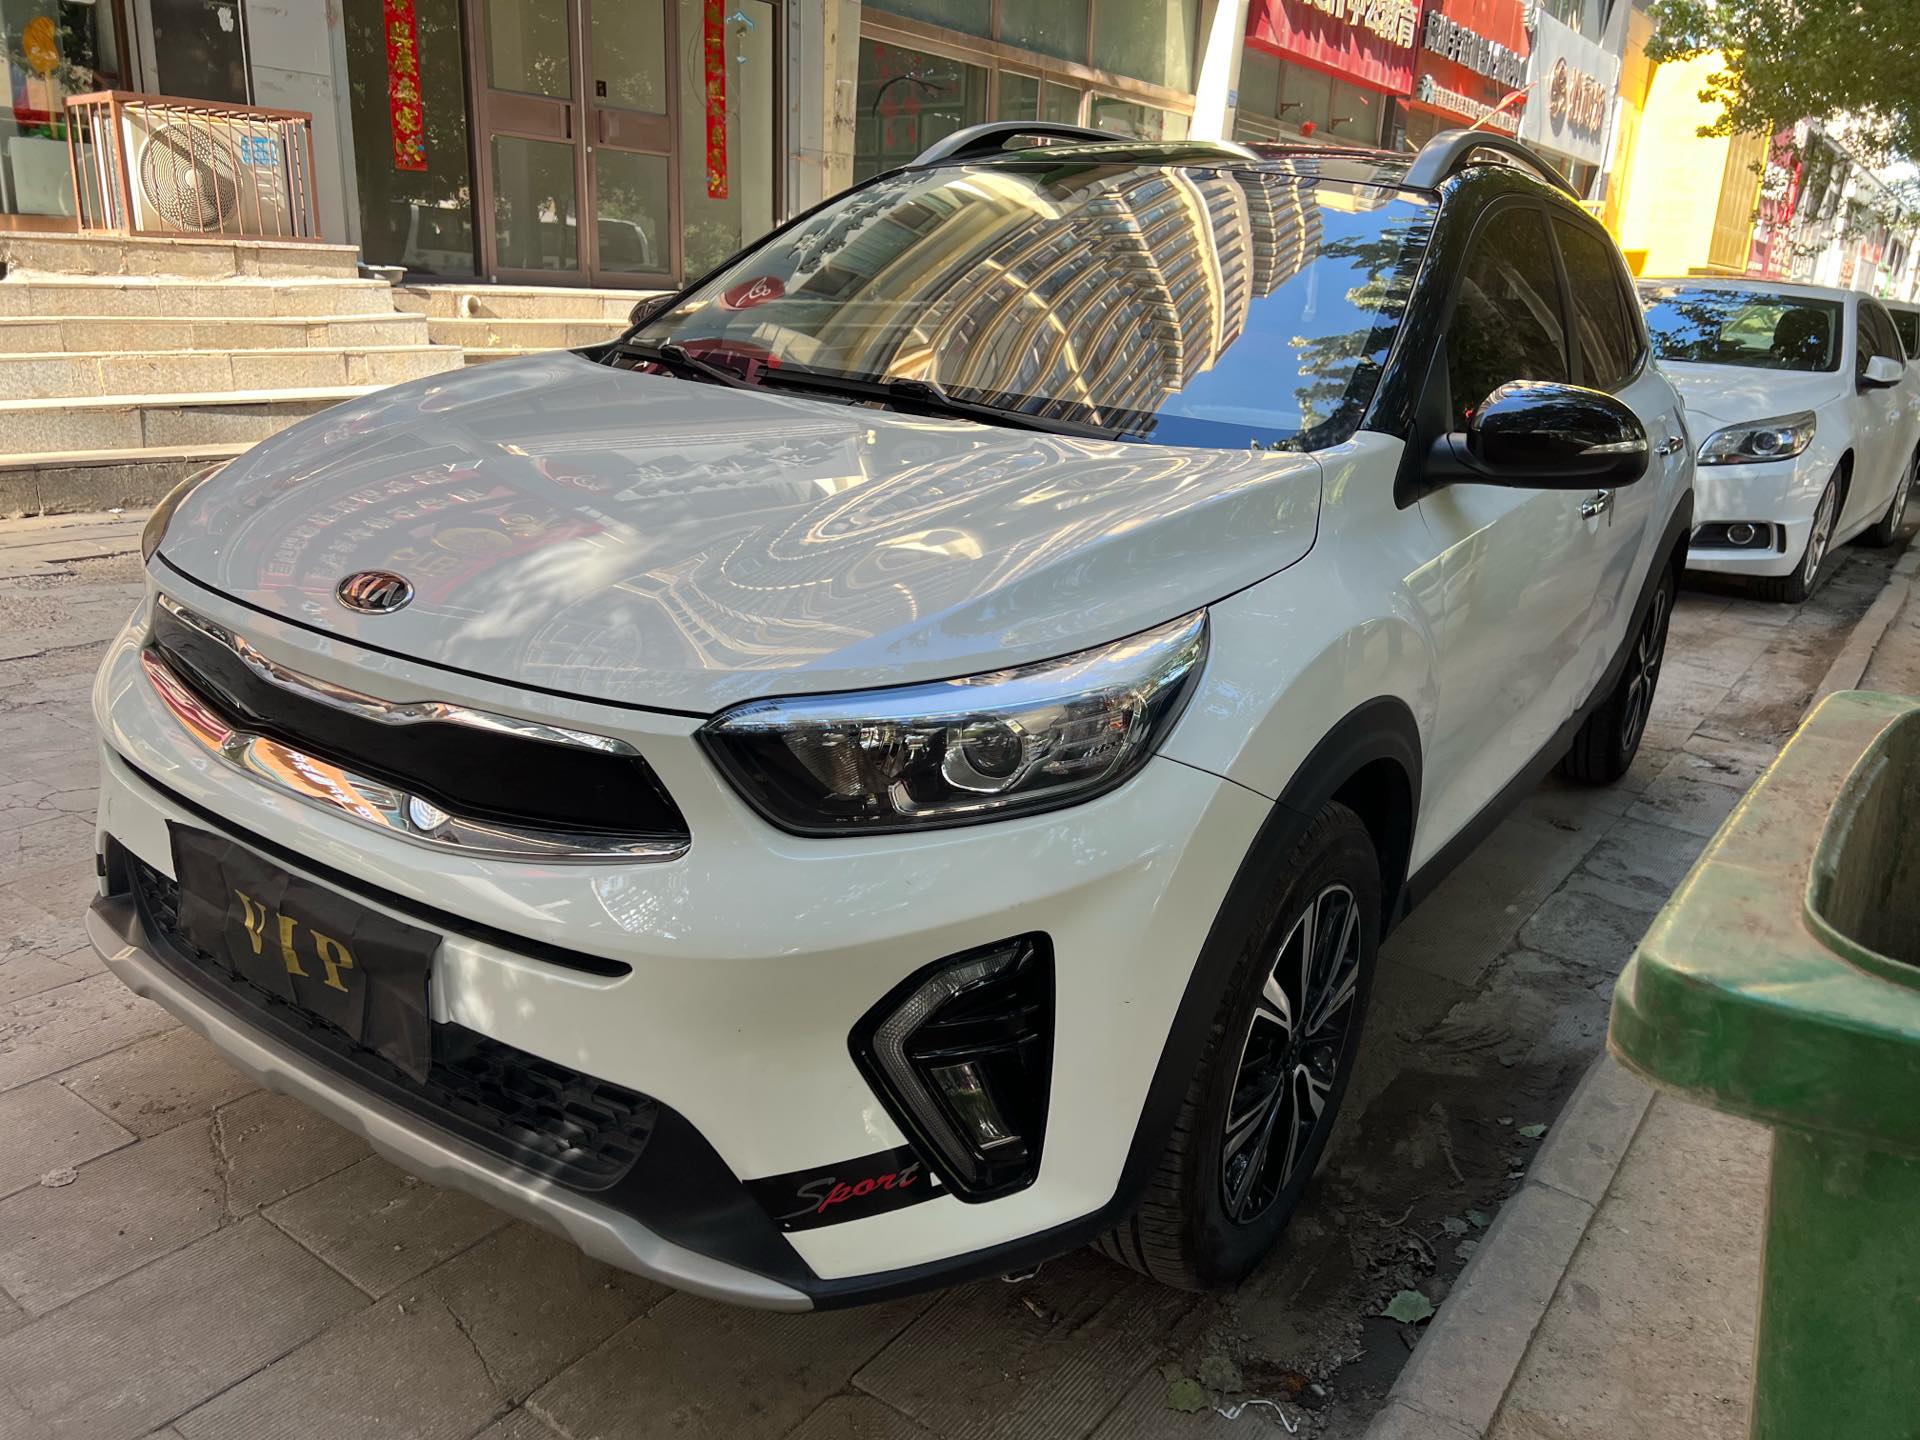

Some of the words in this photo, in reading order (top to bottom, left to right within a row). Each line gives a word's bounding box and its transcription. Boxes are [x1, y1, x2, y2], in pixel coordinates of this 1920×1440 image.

[341, 573, 400, 607] KIA
[234, 888, 354, 993] VIP
[773, 1161, 921, 1220] Sport
